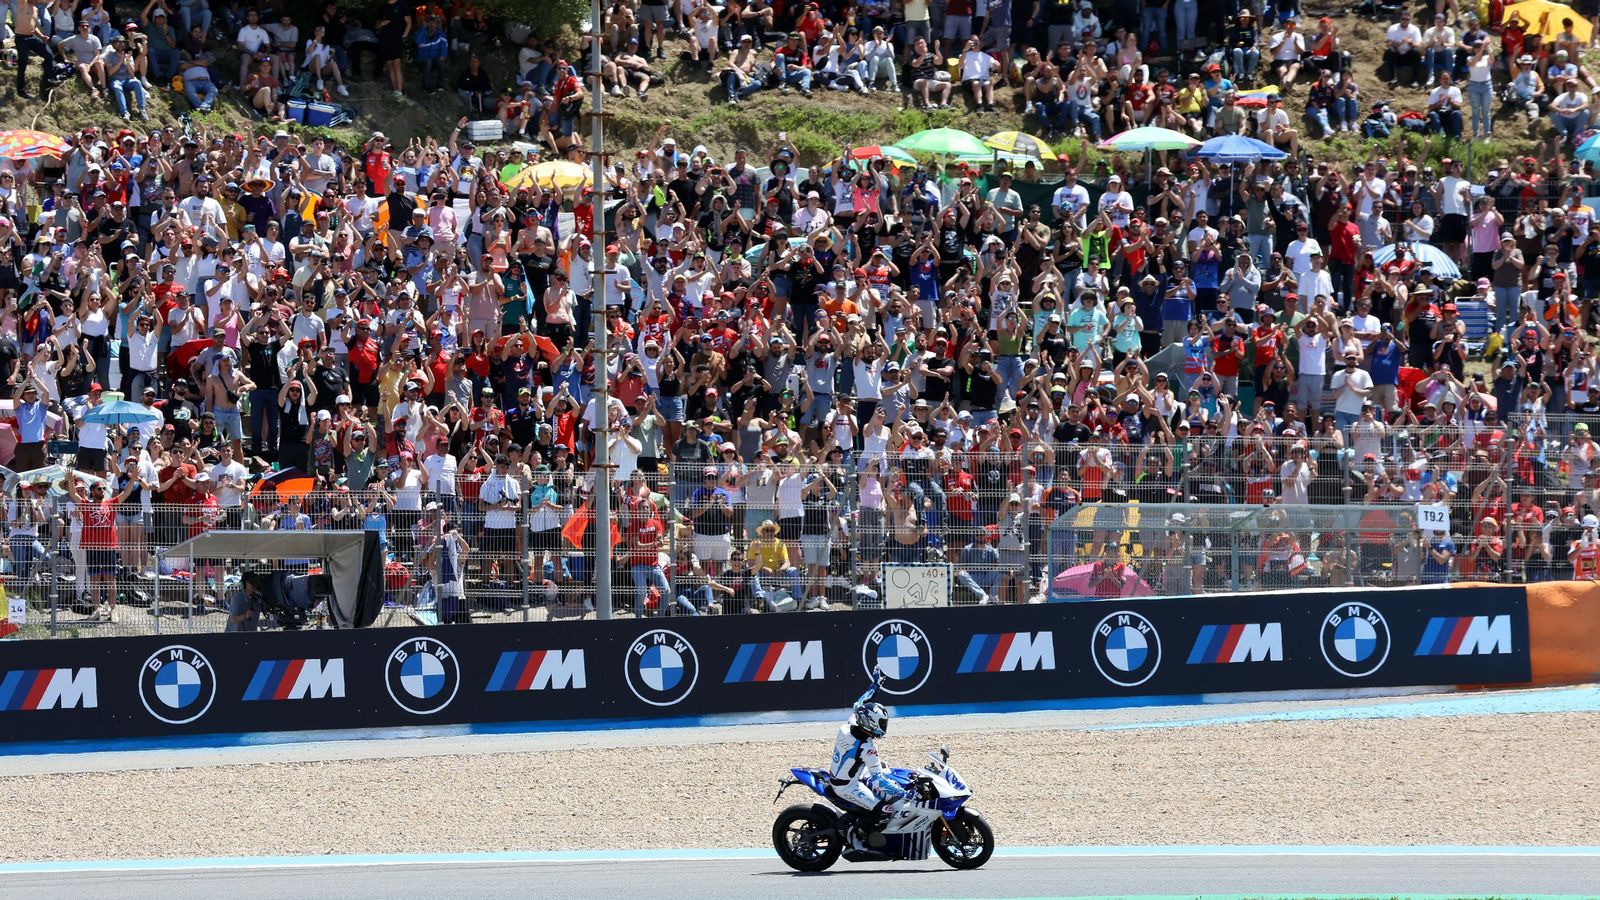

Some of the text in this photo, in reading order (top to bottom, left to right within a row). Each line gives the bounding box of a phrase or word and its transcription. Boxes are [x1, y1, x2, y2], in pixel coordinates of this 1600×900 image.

[1423, 510, 1444, 522] T9.2
[36, 606, 1512, 710] M BMW M BMW M BMW M BMW M BMW M BMW M
